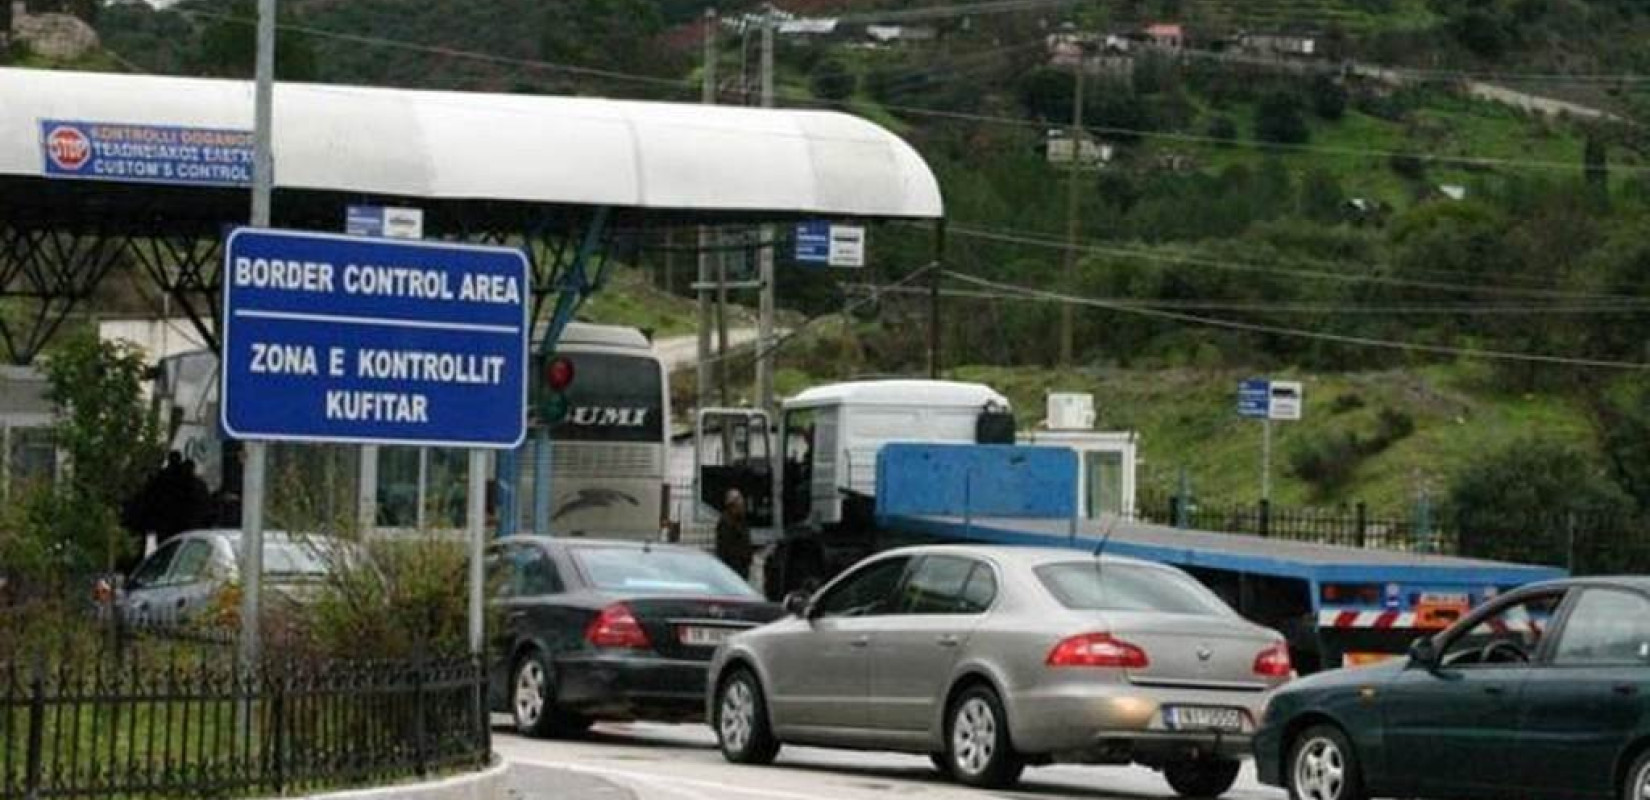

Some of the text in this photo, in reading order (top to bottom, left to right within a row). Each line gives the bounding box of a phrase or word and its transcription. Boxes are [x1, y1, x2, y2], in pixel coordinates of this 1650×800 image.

[51, 139, 86, 159] STOP
[178, 164, 249, 180] CONTROL
[234, 257, 520, 304] BORDER CONTROL AREA
[250, 344, 505, 384] ZONA E KONTROLLIT
[326, 390, 429, 423] KUFITAR
[565, 406, 648, 427] UMI
